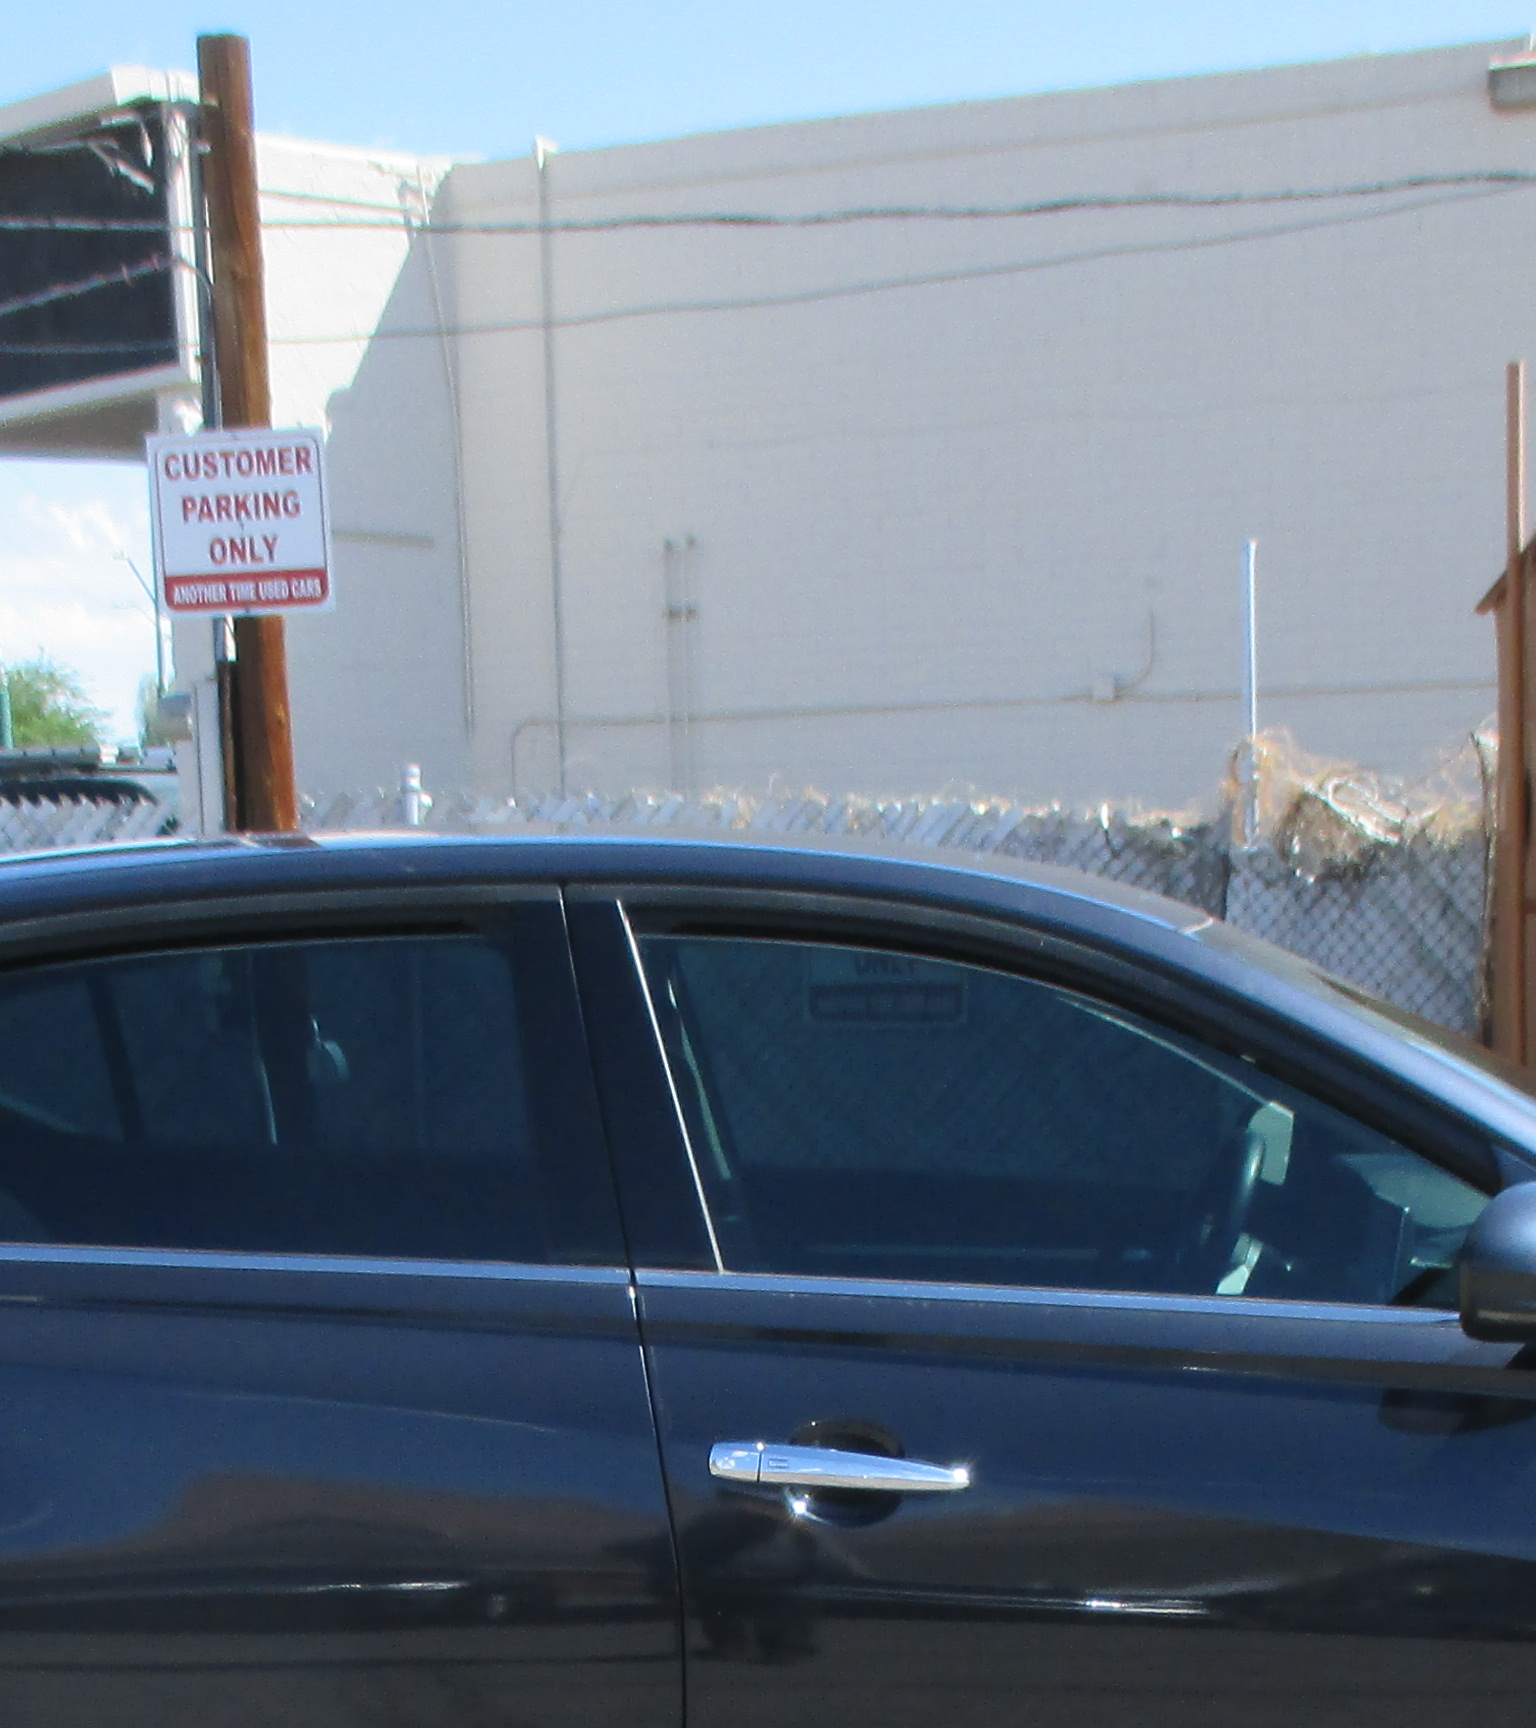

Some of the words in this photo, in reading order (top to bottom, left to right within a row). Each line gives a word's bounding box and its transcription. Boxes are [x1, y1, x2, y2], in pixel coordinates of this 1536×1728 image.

[165, 446, 312, 481] CUSTOMER
[181, 490, 301, 524] PARKING
[209, 534, 279, 566] ONLY
[173, 583, 227, 605] ANOTHER
[259, 578, 289, 600] USED
[292, 576, 322, 598] CARS
